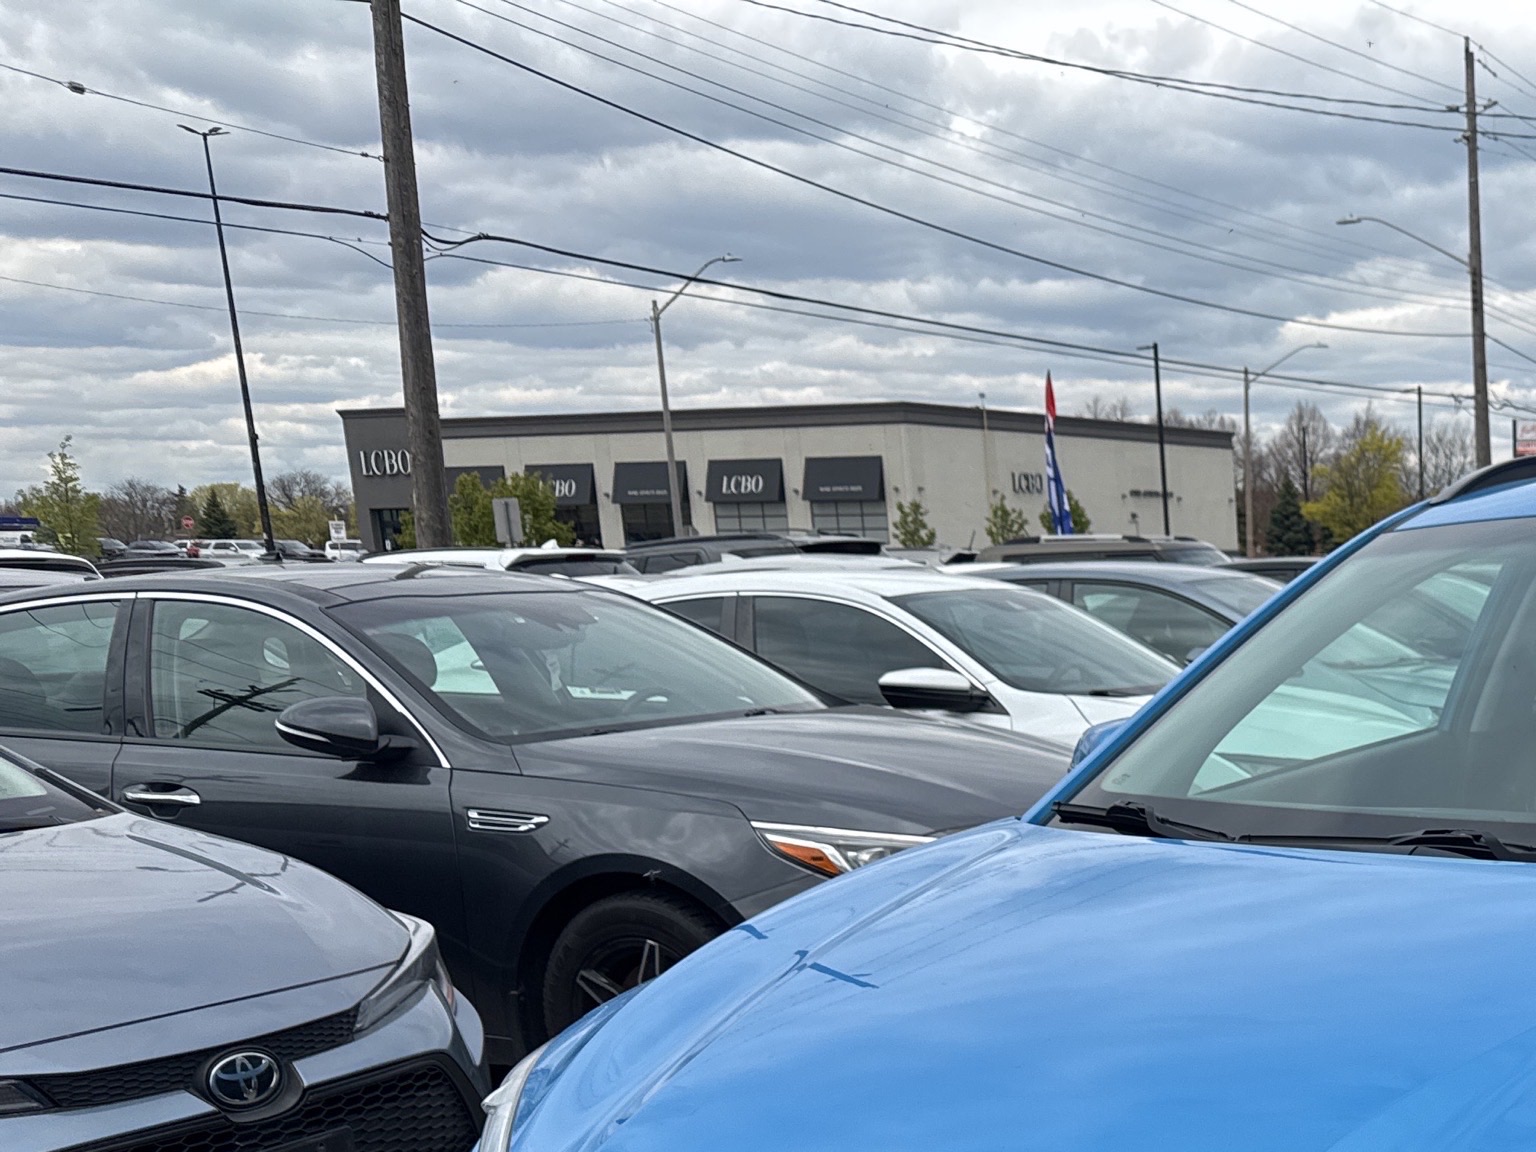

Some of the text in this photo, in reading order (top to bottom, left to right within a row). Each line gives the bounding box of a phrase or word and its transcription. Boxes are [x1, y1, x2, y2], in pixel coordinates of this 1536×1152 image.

[359, 449, 411, 476] LCBO
[721, 474, 764, 495] LCBO
[1011, 471, 1044, 495] LCBO
